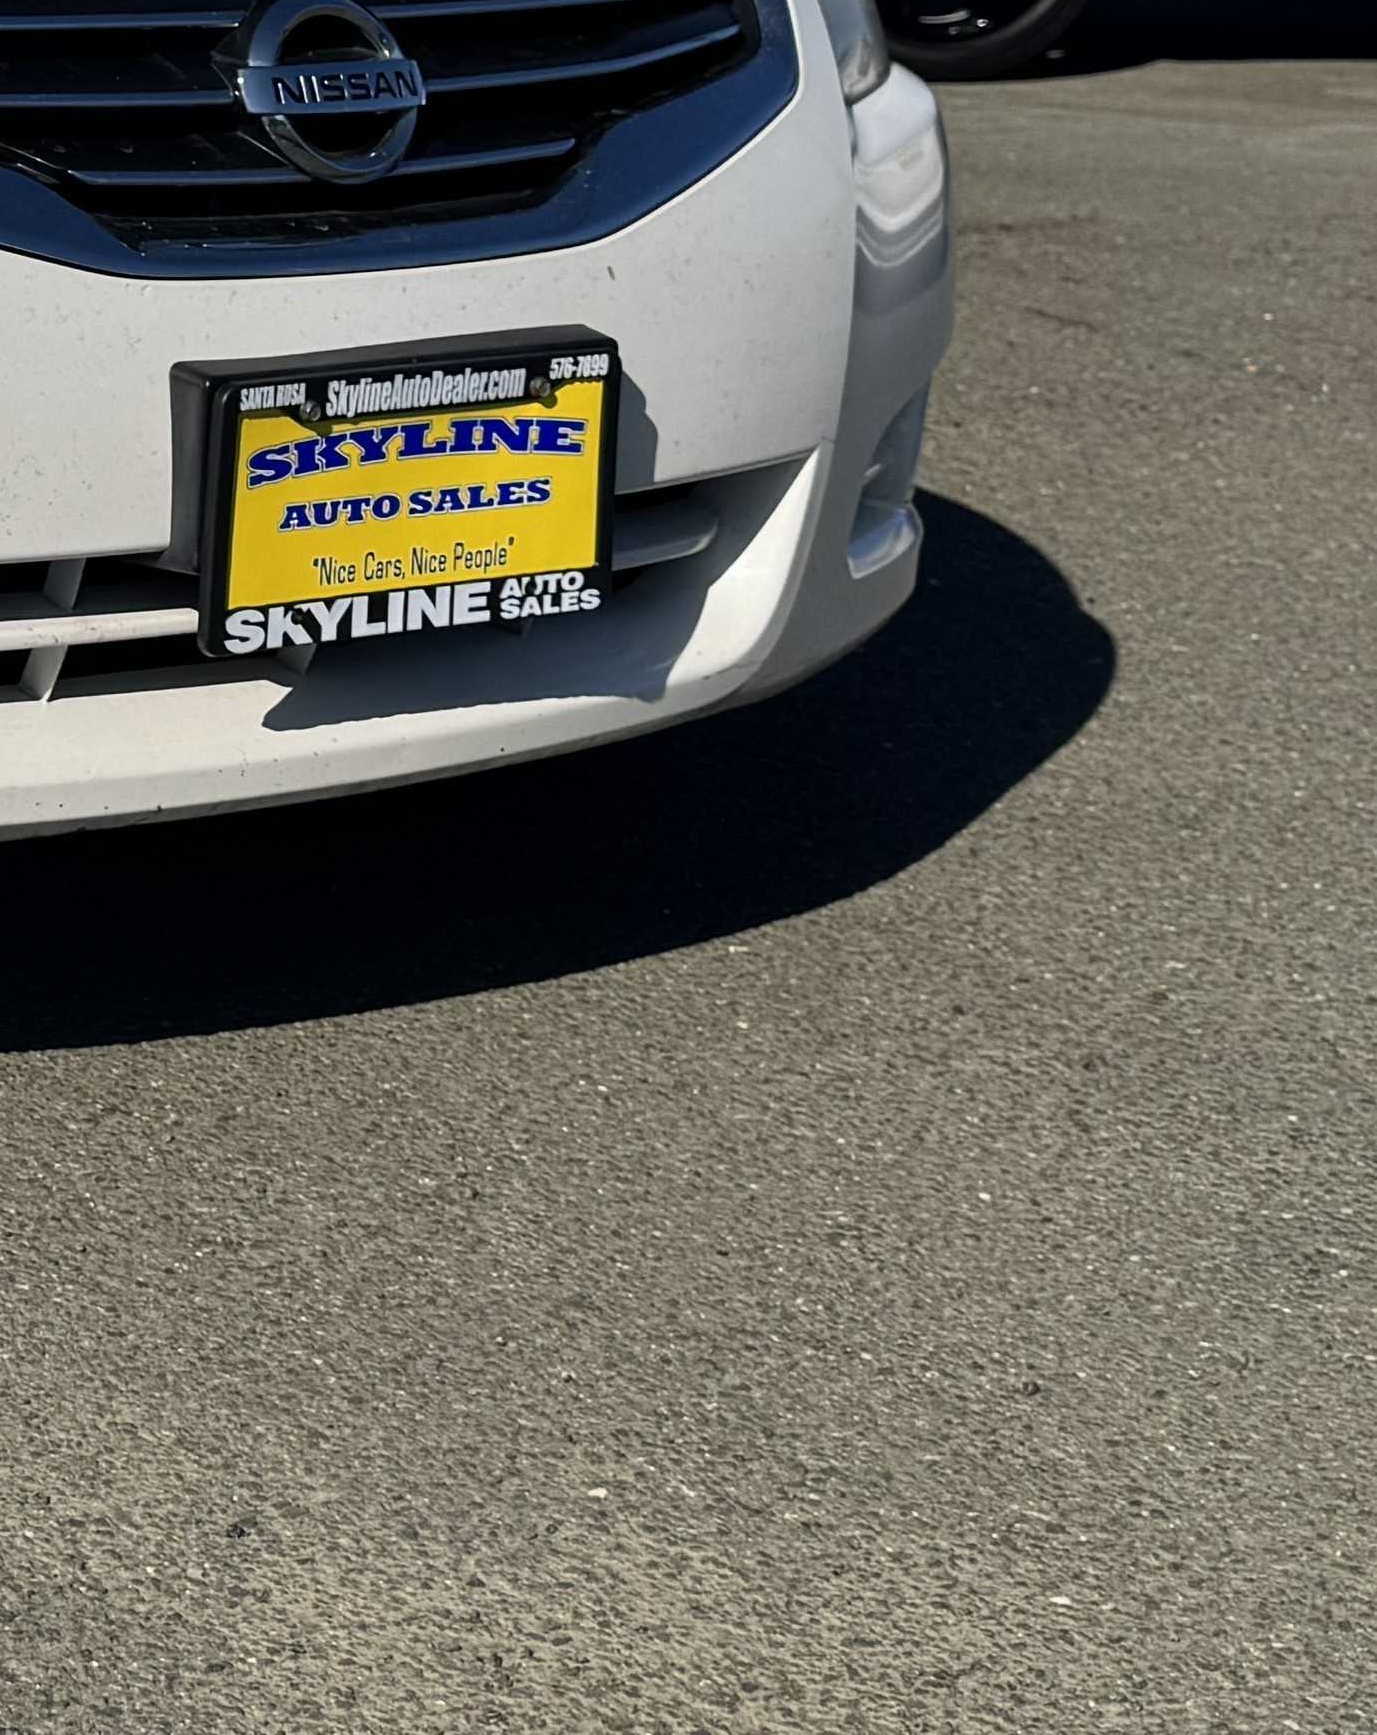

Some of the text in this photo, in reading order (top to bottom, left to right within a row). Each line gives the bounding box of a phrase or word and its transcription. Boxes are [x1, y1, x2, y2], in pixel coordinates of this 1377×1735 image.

[271, 70, 419, 105] NISSAN
[240, 353, 609, 417] SANTA ROSA SkylineAutoDealer.com 576-7899
[246, 418, 588, 490] SKYLINE
[278, 477, 552, 532] AUTO SALES
[363, 551, 406, 581] Cars,
[410, 546, 447, 576] Nice
[223, 571, 585, 655] SKYLINE AUTO
[500, 588, 601, 620] SALES
